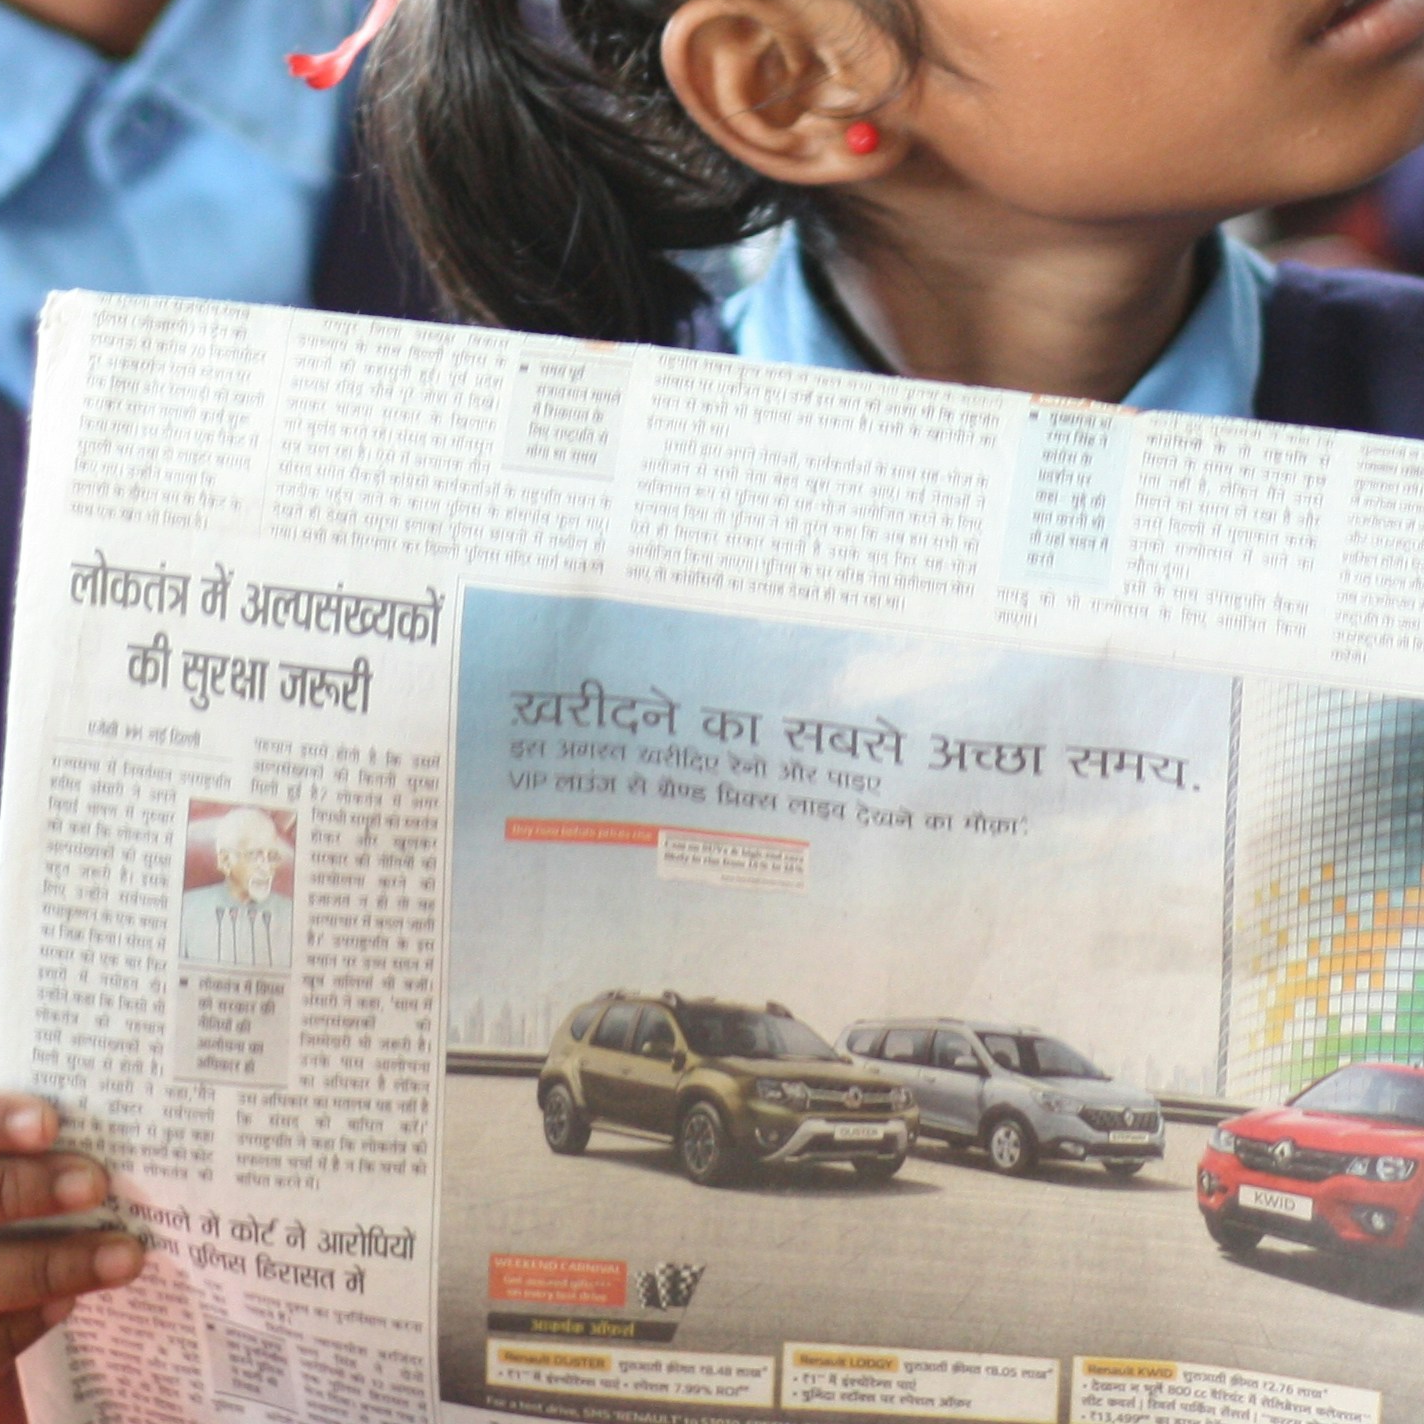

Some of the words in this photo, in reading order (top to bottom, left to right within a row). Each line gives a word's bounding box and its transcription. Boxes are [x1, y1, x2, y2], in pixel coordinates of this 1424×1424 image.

[68, 552, 191, 617] लोकतंत्र
[199, 560, 233, 622] में
[239, 573, 444, 647] अल्पसंख्यकों
[126, 628, 172, 690] की
[178, 650, 268, 717] सुरक्षा
[277, 648, 373, 714] जरूरी
[698, 705, 762, 748] का
[781, 708, 906, 765] सबसे
[927, 732, 1046, 780] अच्छा
[508, 734, 546, 762] इस
[557, 739, 627, 770] अगस्त
[728, 756, 768, 784] रेनो
[779, 761, 818, 789] और
[825, 766, 883, 796] पाइए
[506, 769, 546, 794] VIP
[553, 773, 618, 801] लाउंज
[626, 780, 651, 804] से
[716, 787, 778, 816] प्रिक्स
[786, 794, 846, 822] लाइव
[855, 800, 915, 828] देखने
[923, 805, 954, 832] का
[511, 824, 531, 837] Buy
[1253, 1191, 1296, 1211] KWID
[127, 1196, 194, 1233] मामले
[204, 1209, 224, 1237] में
[230, 1212, 279, 1247] कोर्ट
[284, 1220, 309, 1251] ने
[316, 1215, 417, 1264] आरोपियों
[185, 1242, 249, 1278] पुलिस
[254, 1254, 337, 1291] हिरासत
[344, 1265, 368, 1296] में
[494, 1257, 558, 1272] WEEKEND
[561, 1261, 620, 1274] CARNIVAL
[554, 1354, 606, 1370] DUSTER
[850, 1357, 894, 1370] LODGY
[1087, 1364, 1134, 1377] Renault
[1137, 1366, 1173, 1379] KWID
[1168, 1385, 1191, 1397] 800
[1194, 1389, 1207, 1399] cc
